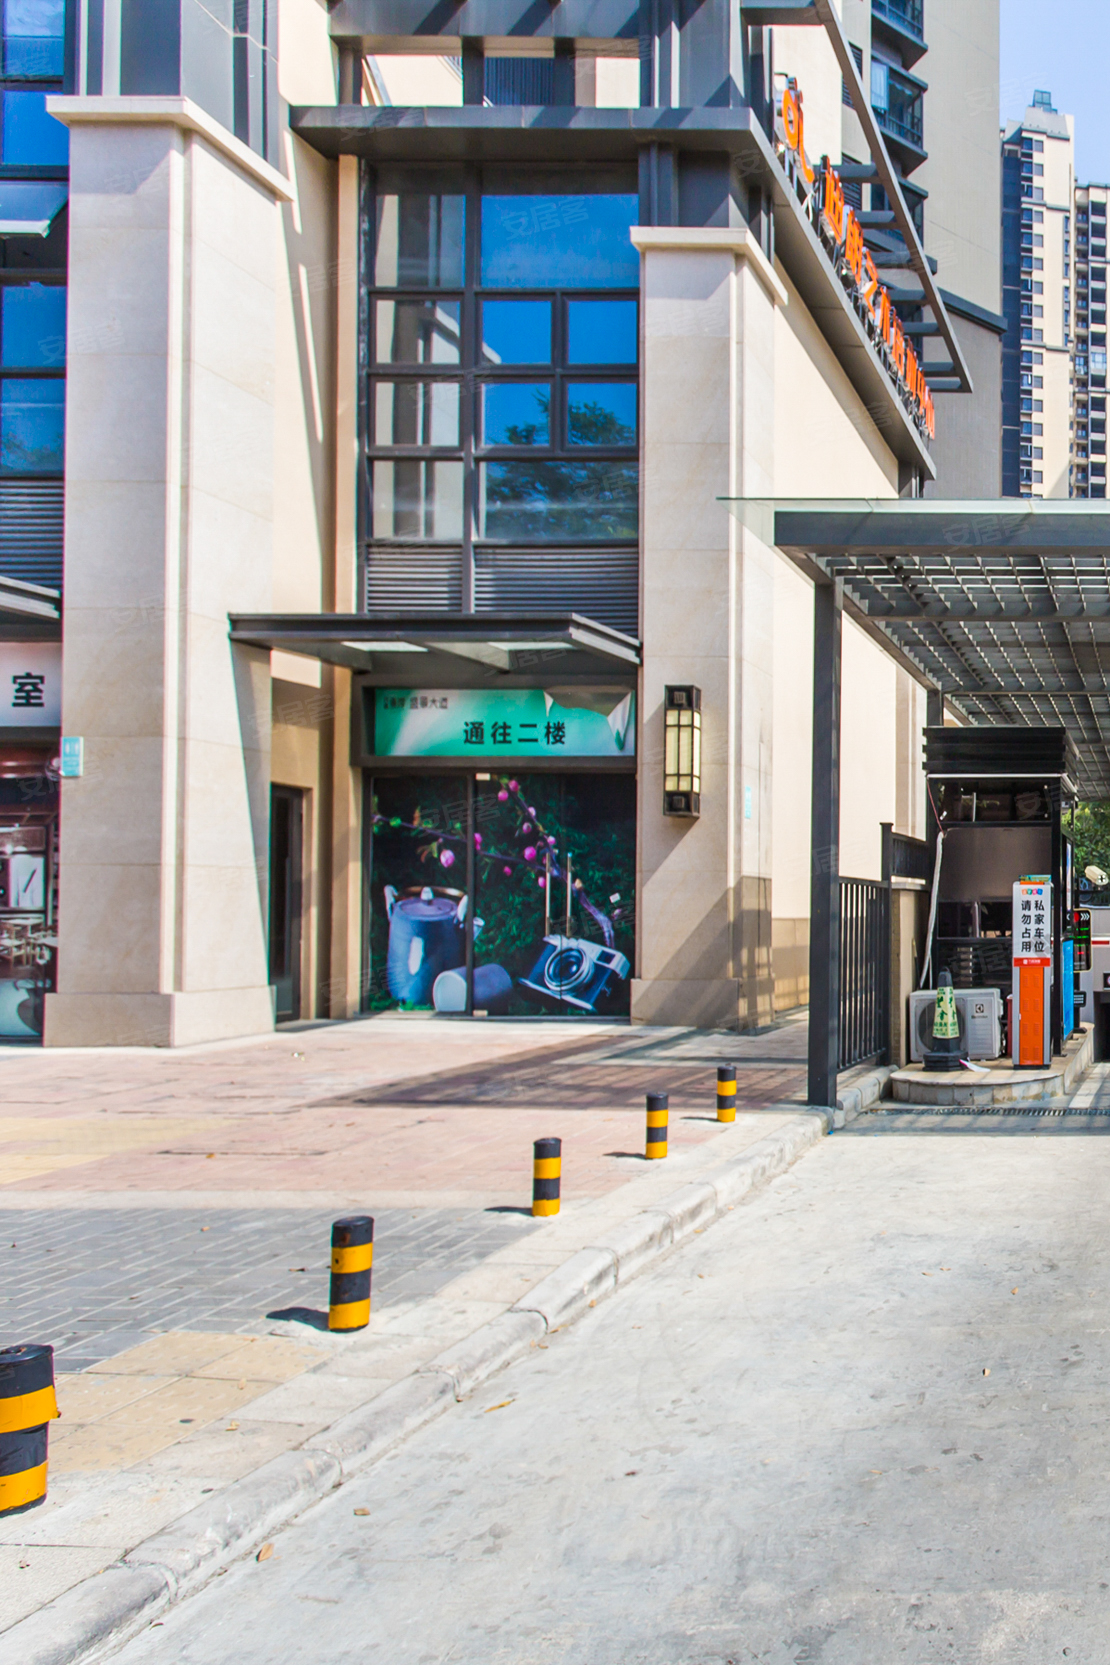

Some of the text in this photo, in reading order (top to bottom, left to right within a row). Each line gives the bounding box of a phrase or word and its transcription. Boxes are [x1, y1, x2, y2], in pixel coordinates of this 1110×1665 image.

[12, 672, 45, 707] 室
[464, 721, 566, 745] 通往二楼
[1021, 899, 1032, 952] 请勿占用
[1034, 899, 1045, 952] 私家车位
